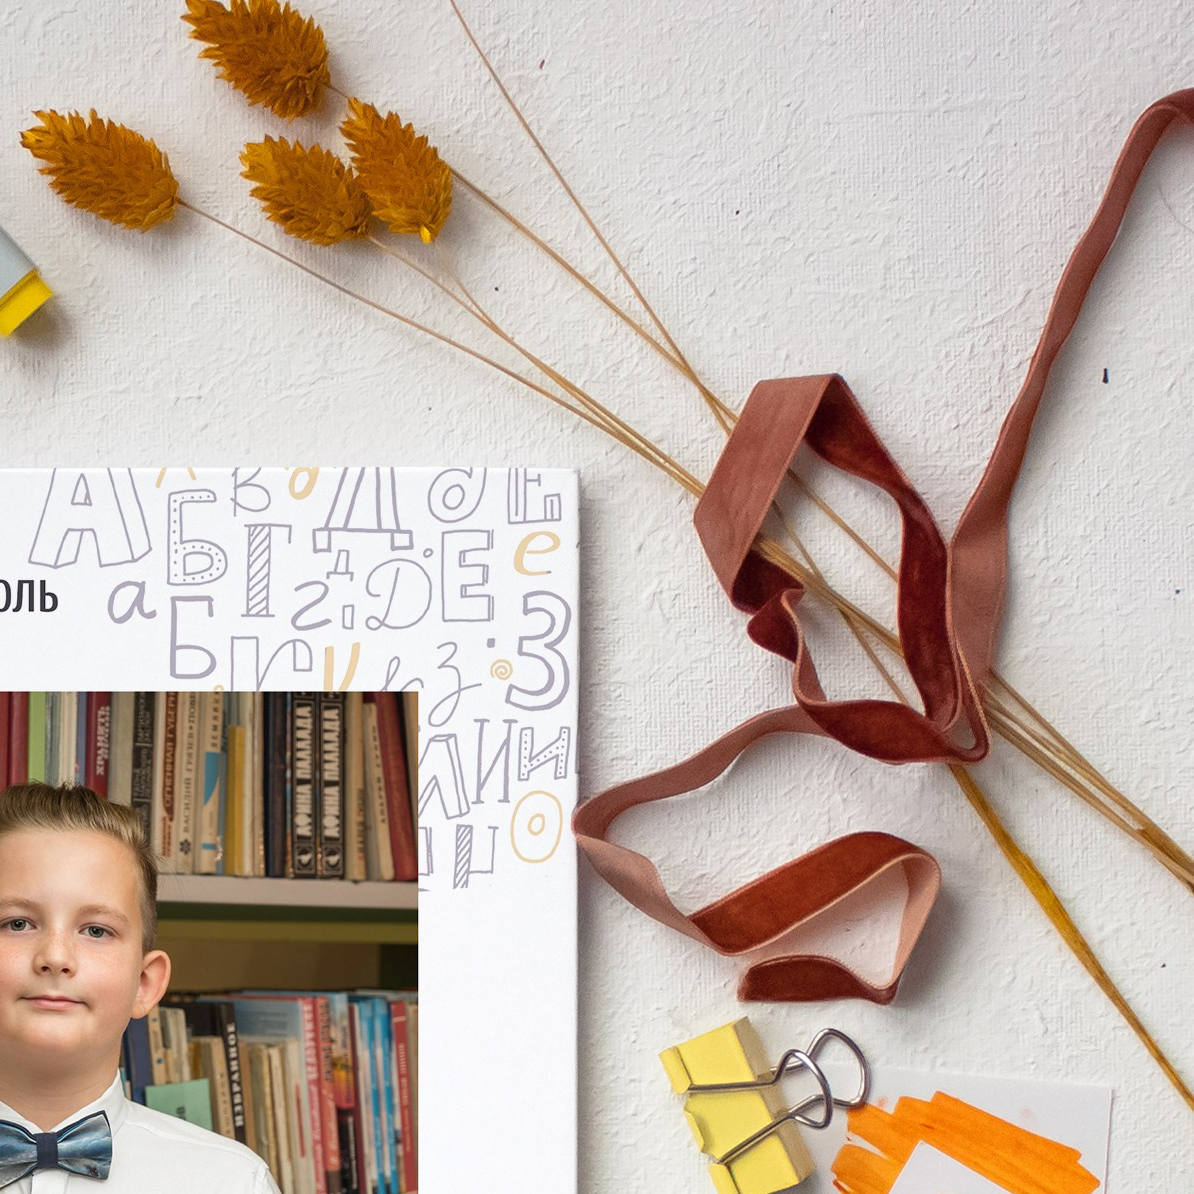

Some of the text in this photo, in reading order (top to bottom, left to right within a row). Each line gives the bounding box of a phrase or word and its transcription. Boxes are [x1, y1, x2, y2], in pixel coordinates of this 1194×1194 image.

[164, 741, 174, 807] ОГНЕННАЯ
[185, 732, 194, 773] ГРЯЗЕВ
[295, 706, 313, 837] АФИНА ПАЛЛАДА
[322, 708, 340, 838] АФИНА ПАЛЛАДА
[182, 777, 192, 834] ВАСИЛИЙ
[226, 1022, 245, 1127] ИЗБРАННОЕ
